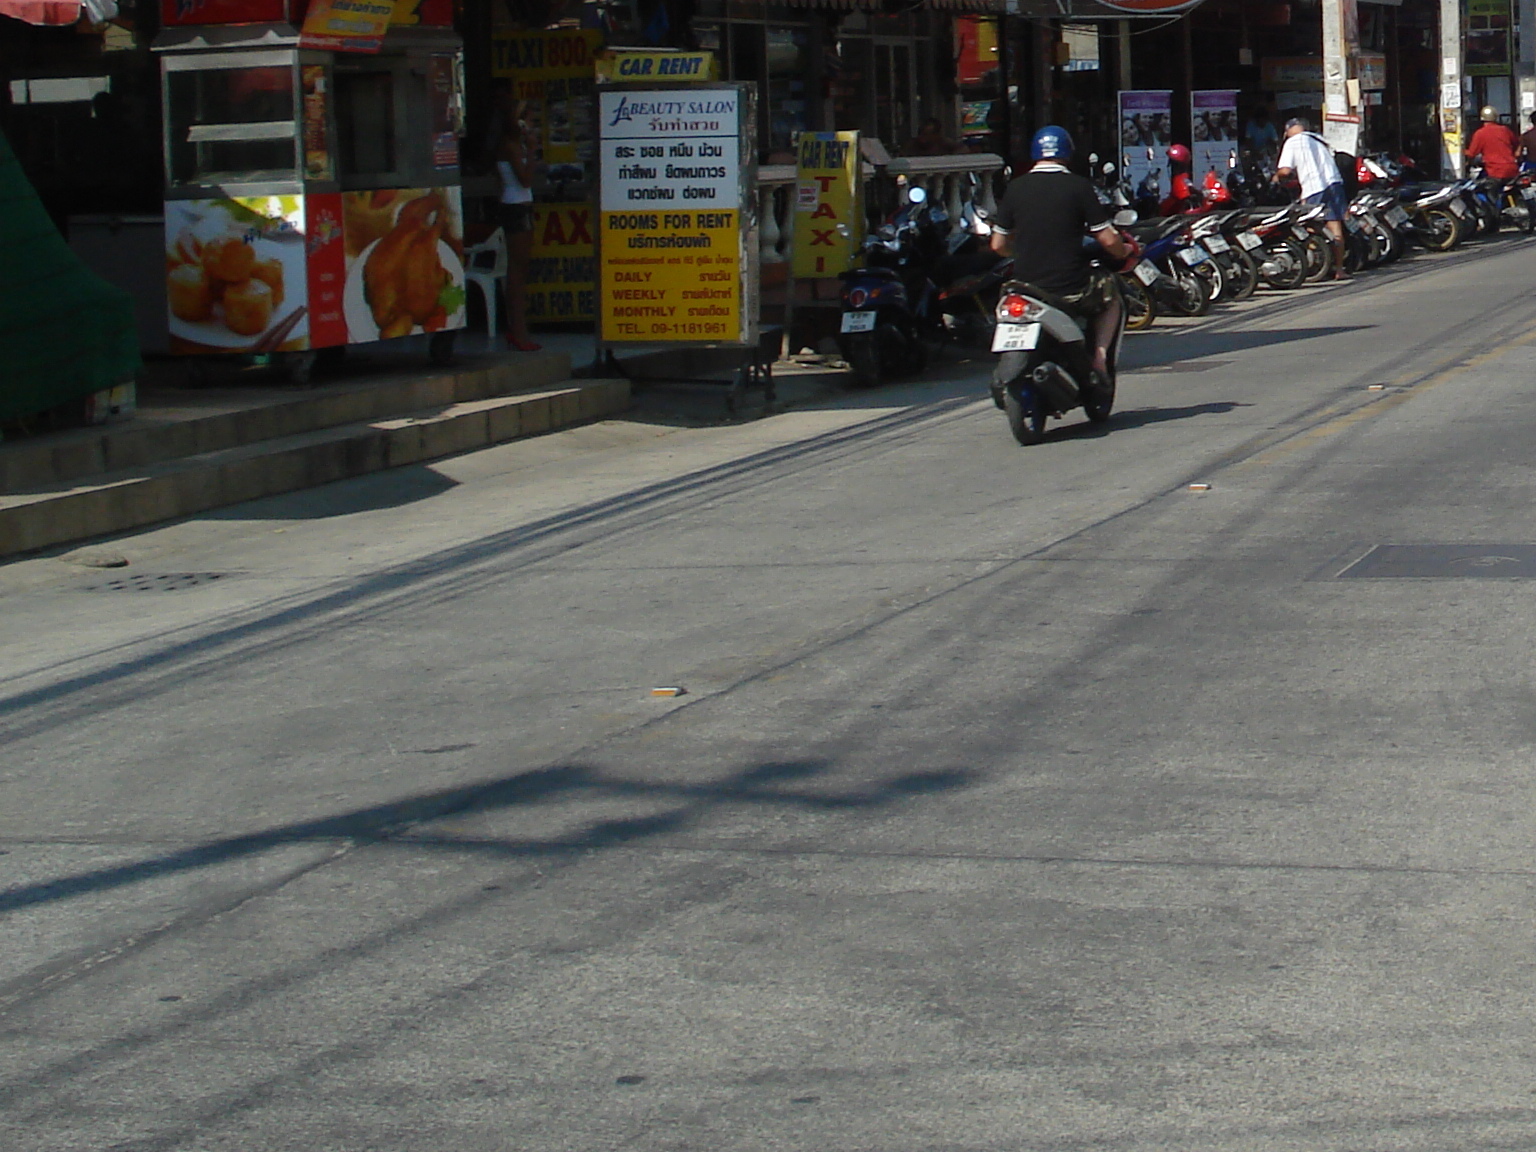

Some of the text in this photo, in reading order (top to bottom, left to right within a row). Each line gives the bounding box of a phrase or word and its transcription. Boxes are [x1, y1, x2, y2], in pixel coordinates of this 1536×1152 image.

[494, 37, 543, 69] TAXI
[619, 56, 704, 76] CAR RENT
[630, 101, 687, 116] BEAUTY
[687, 101, 736, 115] SALON
[534, 208, 593, 246] AX
[608, 213, 733, 230] ROOMS FOR RENT
[809, 175, 838, 273] TAXI
[614, 272, 653, 283] DAILY
[612, 289, 667, 301] WEEKLY
[612, 306, 677, 317] MONTHLY
